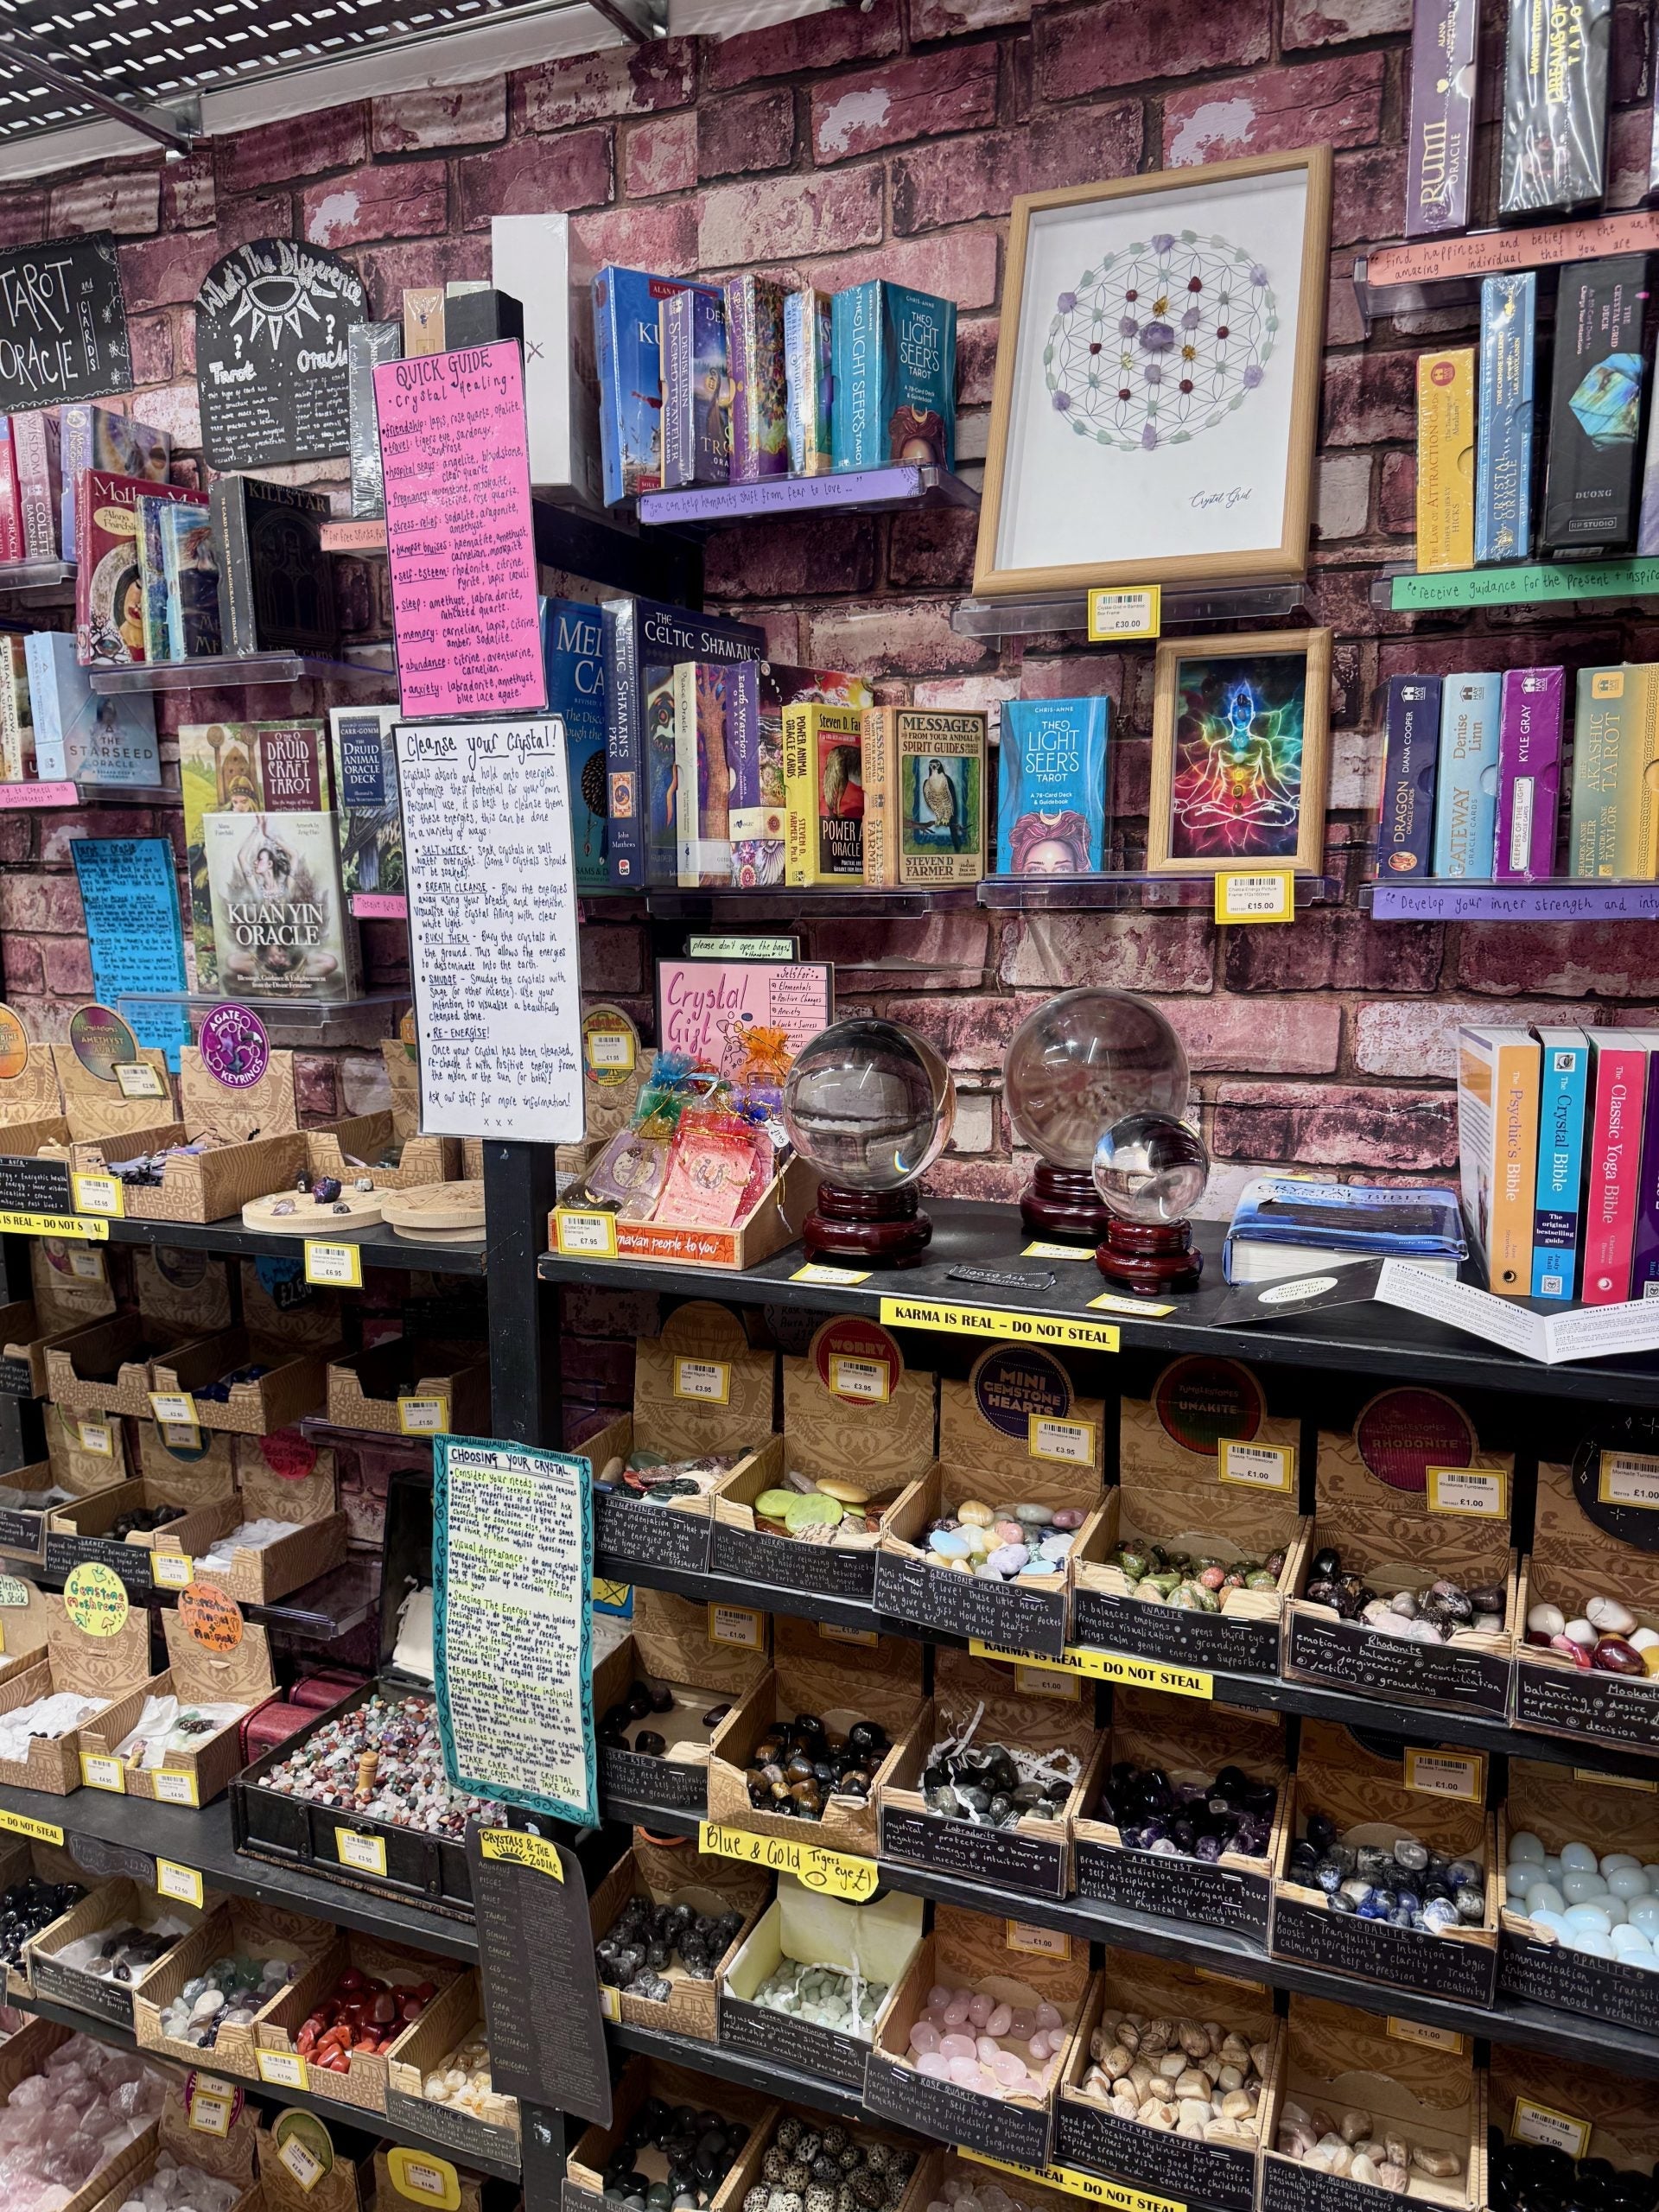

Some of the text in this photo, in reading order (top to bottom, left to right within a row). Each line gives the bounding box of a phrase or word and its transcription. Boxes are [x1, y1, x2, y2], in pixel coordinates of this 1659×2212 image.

[1448, 132, 1460, 184] ORACLE
[1424, 238, 1520, 260] happiness and
[0, 257, 73, 334] TAROT
[912, 311, 932, 328] THE
[902, 319, 939, 348] LIGHT
[900, 342, 940, 372] SEER'S
[208, 359, 257, 385] Tarot
[396, 348, 492, 391] QUICK GUIDE
[908, 366, 931, 379] TAROT
[248, 482, 326, 514] KILLSTAR
[701, 486, 805, 510] humanity shift from fear
[1188, 486, 1252, 510] Crystal Grid
[1493, 457, 1505, 520] CRYSTAL
[1506, 460, 1516, 519] ORACLE
[1575, 490, 1612, 499] DUONG
[1583, 519, 1614, 528] STUDIO
[1420, 575, 1560, 600] receive guidance the
[656, 612, 672, 626] THE
[645, 620, 760, 661] CELTIC SHAMAN'S
[617, 680, 629, 758] SHAMAN'S
[902, 716, 979, 733] MESSAGES
[1042, 721, 1070, 732] THE
[608, 727, 618, 758] PACK
[785, 719, 795, 752] ORACLE
[1029, 730, 1079, 751] LIGHT
[1452, 714, 1467, 760] Denise
[1468, 721, 1483, 752] Linn
[1519, 704, 1531, 763] KYLE GRAY
[69, 745, 153, 760] STARSEED
[267, 741, 309, 760] DRUID
[343, 742, 379, 755] DRUID
[467, 734, 499, 771] your
[797, 715, 808, 779] POWER ANIMAL
[902, 741, 965, 753] SPIRIT GUIDES
[1587, 713, 1603, 791] AKASHIC
[1601, 712, 1620, 792] TAROT
[92, 759, 134, 768] ORACLE
[268, 760, 309, 778] CRAFT
[344, 755, 380, 765] ANIMAL
[345, 764, 380, 774] ORACLE
[1026, 752, 1079, 773] SEER'S
[270, 779, 311, 794] TAROT
[350, 774, 377, 784] DECK
[1037, 773, 1068, 782] TAROT
[1393, 710, 1414, 843] DRAGON DIANA COOPER
[823, 820, 855, 841] POWER
[1448, 786, 1470, 877] GATEWAY
[1605, 805, 1617, 861] TAYLOR
[832, 842, 860, 856] ORACLE
[906, 857, 943, 866] STEVEN
[906, 866, 954, 876] FARMER
[425, 883, 487, 893] BREATH CLEANSE
[226, 903, 323, 925] KUAN YIN
[1401, 894, 1627, 913] Develop your inner strength and
[236, 925, 321, 945] ORACLE
[693, 940, 791, 956] please don't open the bags!
[667, 971, 749, 1021] Crystal
[779, 982, 811, 991] Elementals
[777, 994, 798, 1002] Positive
[209, 1010, 240, 1032] AGATE
[668, 1009, 711, 1053] Gift
[221, 1058, 263, 1084] KEYRINGS
[1506, 1089, 1523, 1202] Psychic's Bible
[1552, 1093, 1573, 1192] Crystal Bible
[1602, 1084, 1627, 1224] Classic Yoga Bible
[3, 1216, 77, 1230] IS REAL DO NOT
[1536, 1229, 1574, 1238] bestselling
[652, 1237, 682, 1254] people
[894, 1306, 1111, 1344] KARMA IS REAL DO NOT STEAL
[830, 1338, 887, 1356] WORRY
[854, 1382, 872, 1393] £3.95
[1001, 1367, 1047, 1389] MINI
[983, 1381, 1061, 1408] GEMSTONE
[1178, 1400, 1239, 1417] UNAKITE
[1056, 1446, 1076, 1456] £3.95
[1372, 1436, 1459, 1452] RHODONITE
[451, 1448, 531, 1471] CHOOSING YOUR
[1247, 1469, 1269, 1480] £1.00
[1459, 1497, 1484, 1509] £1.00
[71, 1580, 124, 1601] Gemstone
[930, 1568, 1010, 1594] GEMSTONE HEARTS
[965, 1624, 993, 1637] drawn
[1368, 1635, 1422, 1655] Rhodonite
[1296, 1635, 1483, 1677] emotional balancer nurtures
[1103, 1661, 1205, 1691] DO NOT STEAL
[1380, 1676, 1436, 1696] grounding
[1422, 1671, 1501, 1693] reconciliation
[1435, 1779, 1459, 1791] £1.00
[944, 1822, 996, 1840] Labradorite
[482, 1831, 550, 1858] CRYSTALS THE
[529, 1854, 558, 1874] ZODIAC
[707, 1825, 853, 1891] Blue & Gold Tigers eye
[1130, 1855, 1193, 1872] AMETHYST
[1349, 1918, 1409, 1942] SODALITE
[1084, 2182, 1135, 2206] DO NOT
